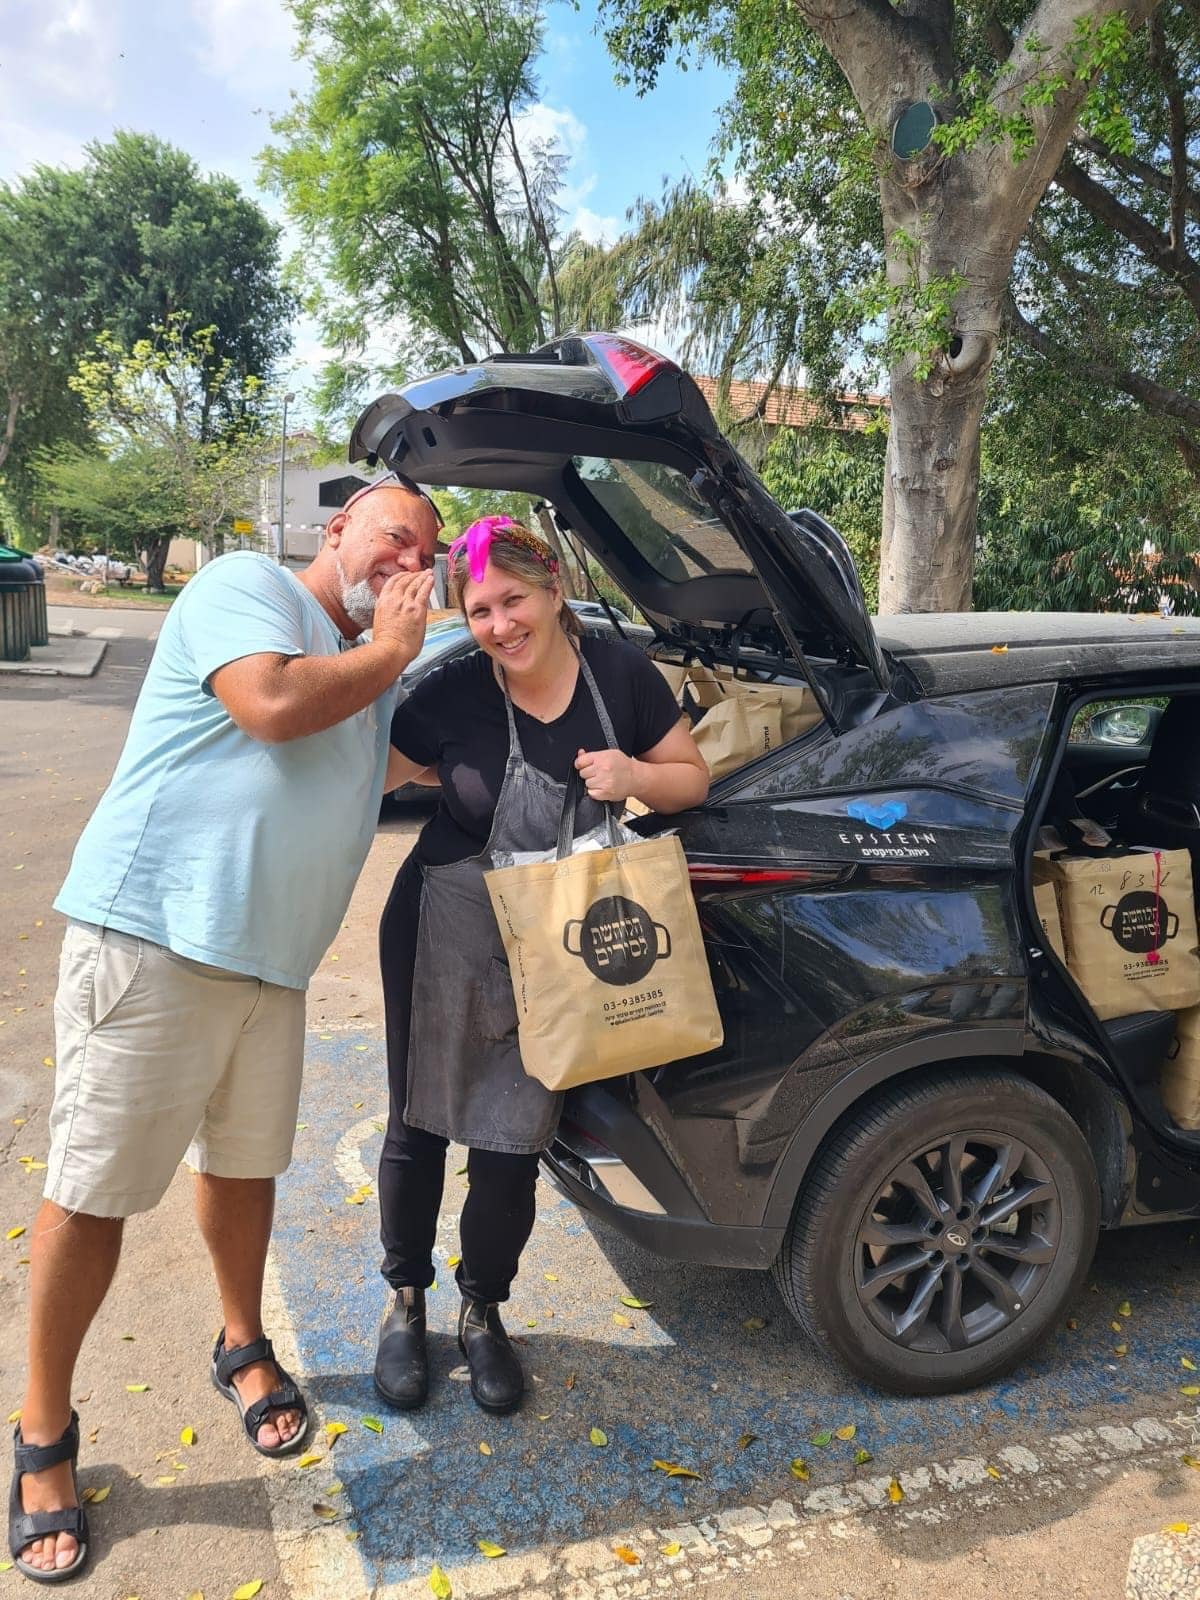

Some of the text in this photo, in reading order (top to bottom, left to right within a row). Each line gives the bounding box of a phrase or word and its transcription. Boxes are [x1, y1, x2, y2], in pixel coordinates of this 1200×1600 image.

[838, 833, 936, 844] EPSTEIN
[590, 917, 643, 945] הלוחשת
[595, 933, 648, 967] לסירים
[603, 988, 663, 1012] 03-9385385
